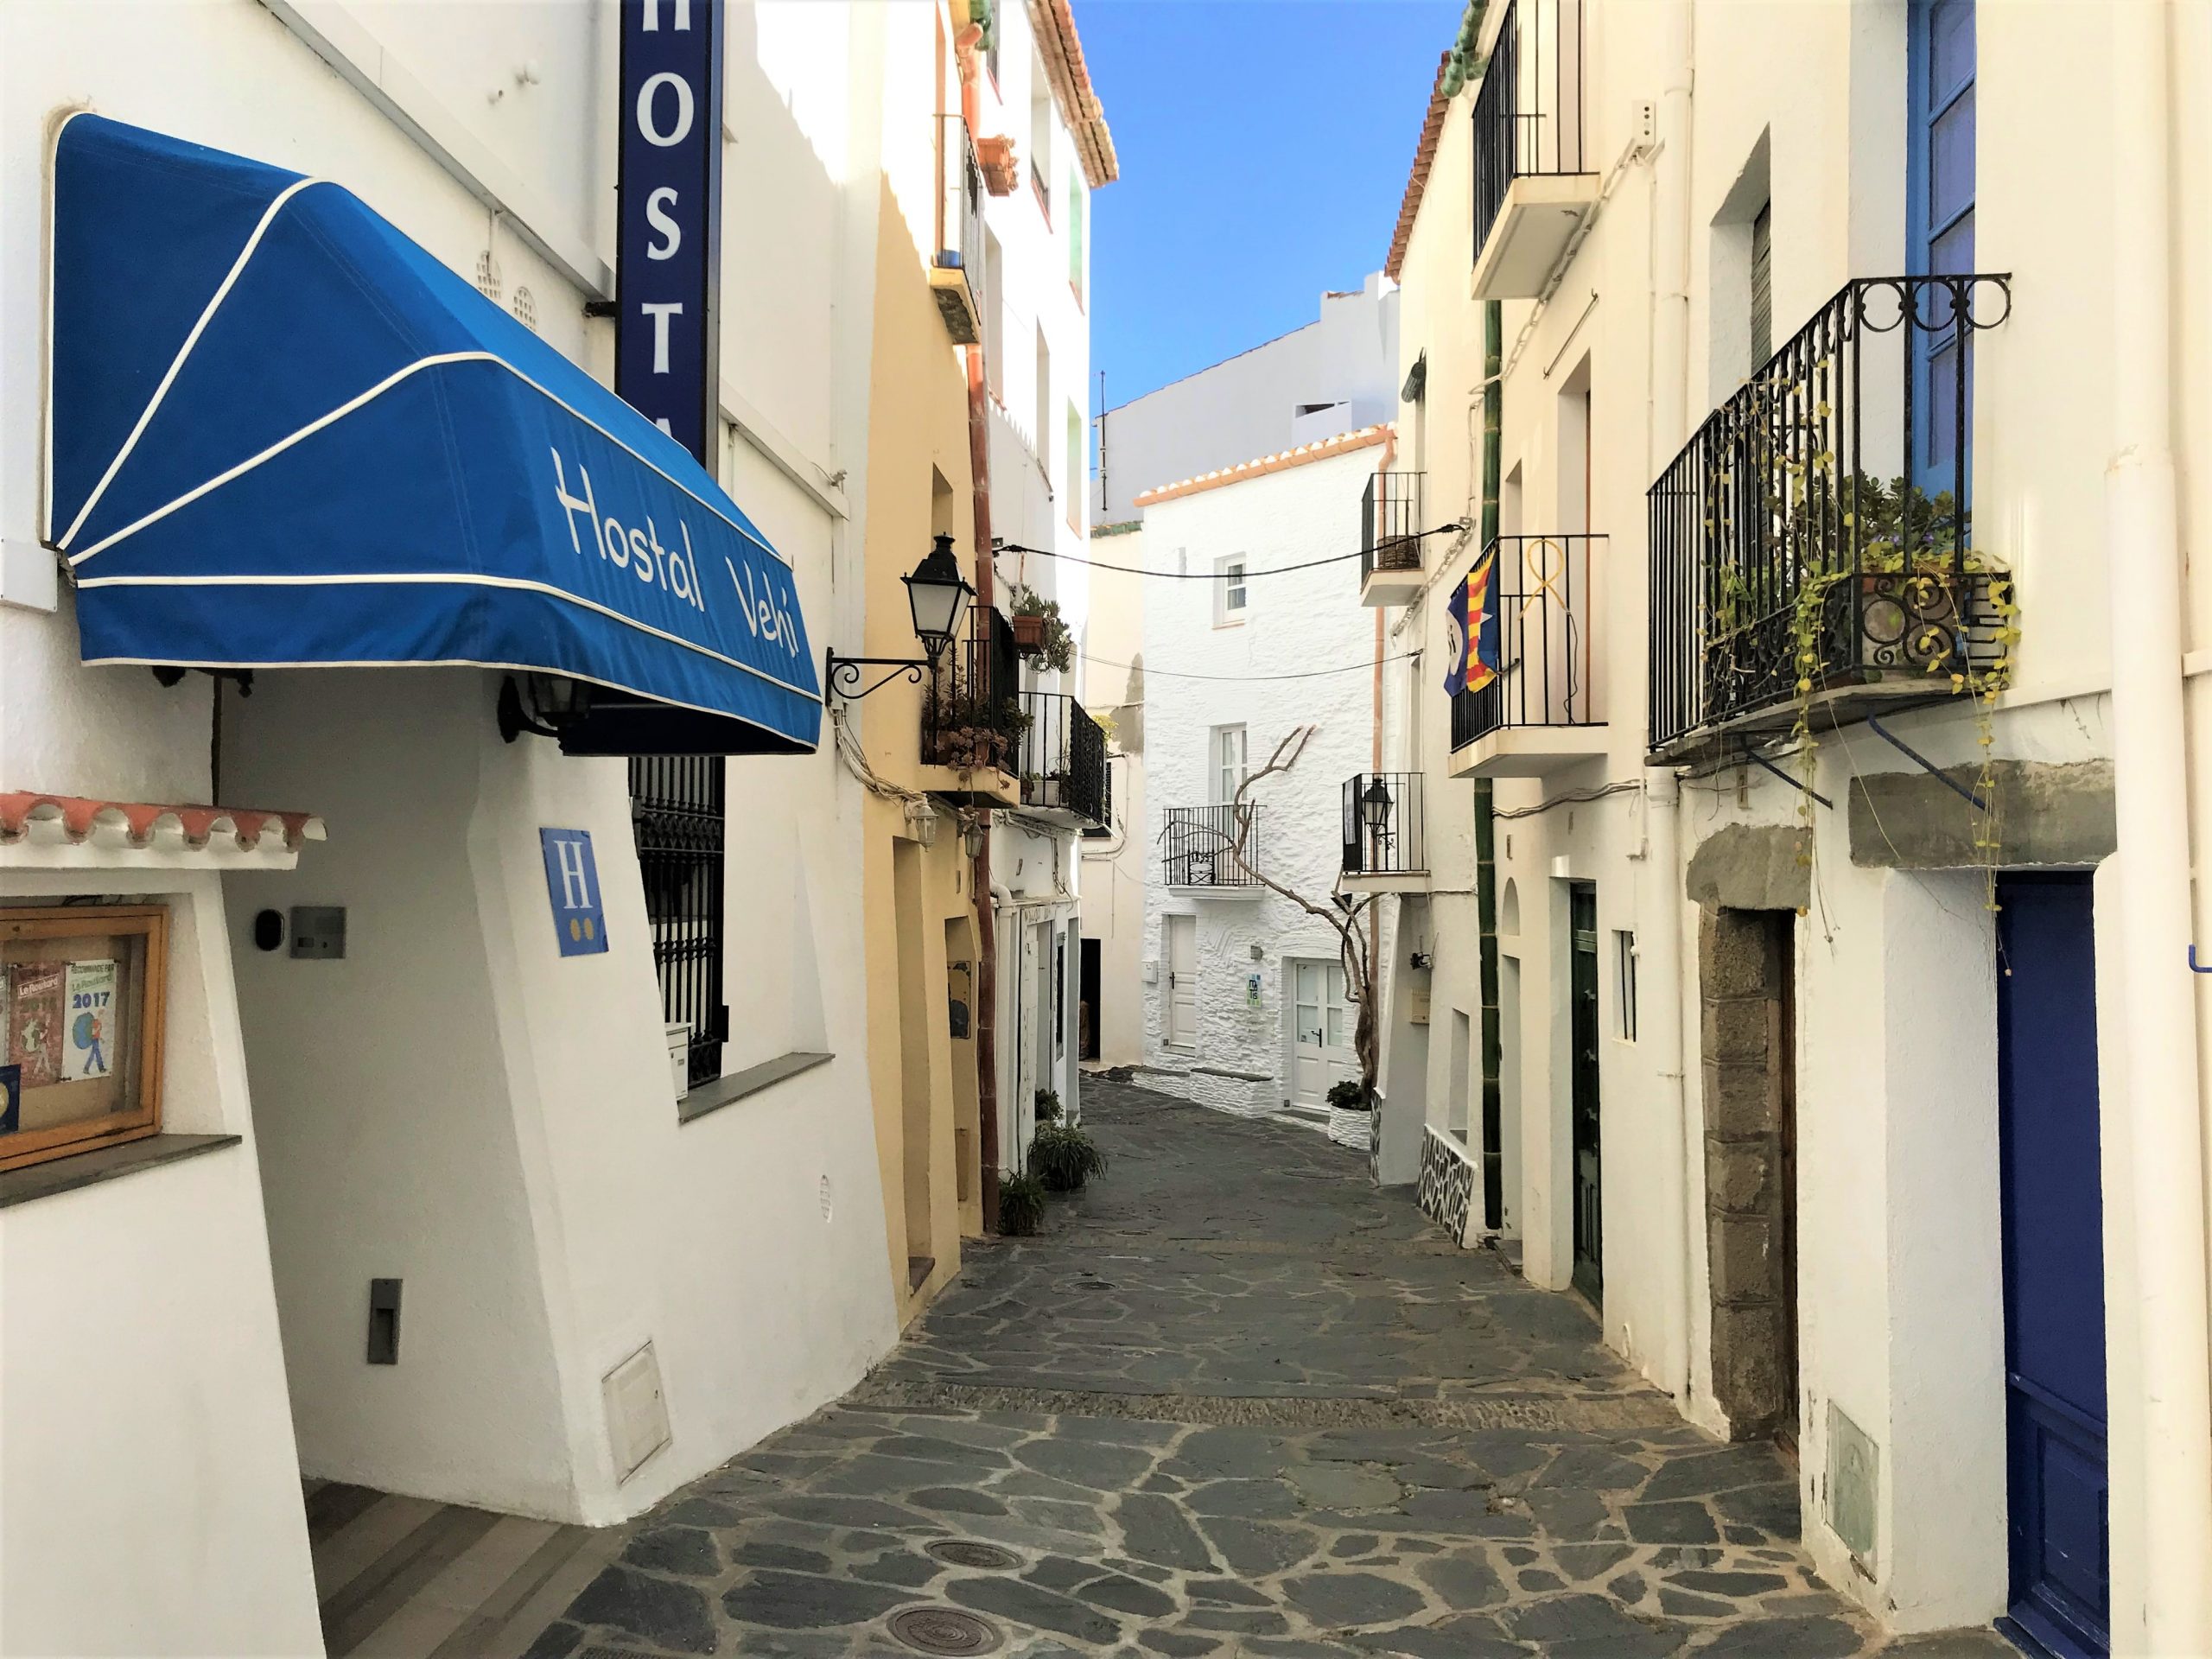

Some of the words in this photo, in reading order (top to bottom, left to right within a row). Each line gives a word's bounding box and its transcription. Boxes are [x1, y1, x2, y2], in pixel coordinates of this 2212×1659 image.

[550, 446, 705, 613] Hostal
[553, 840, 594, 910] H
[73, 991, 111, 1009] 2017
